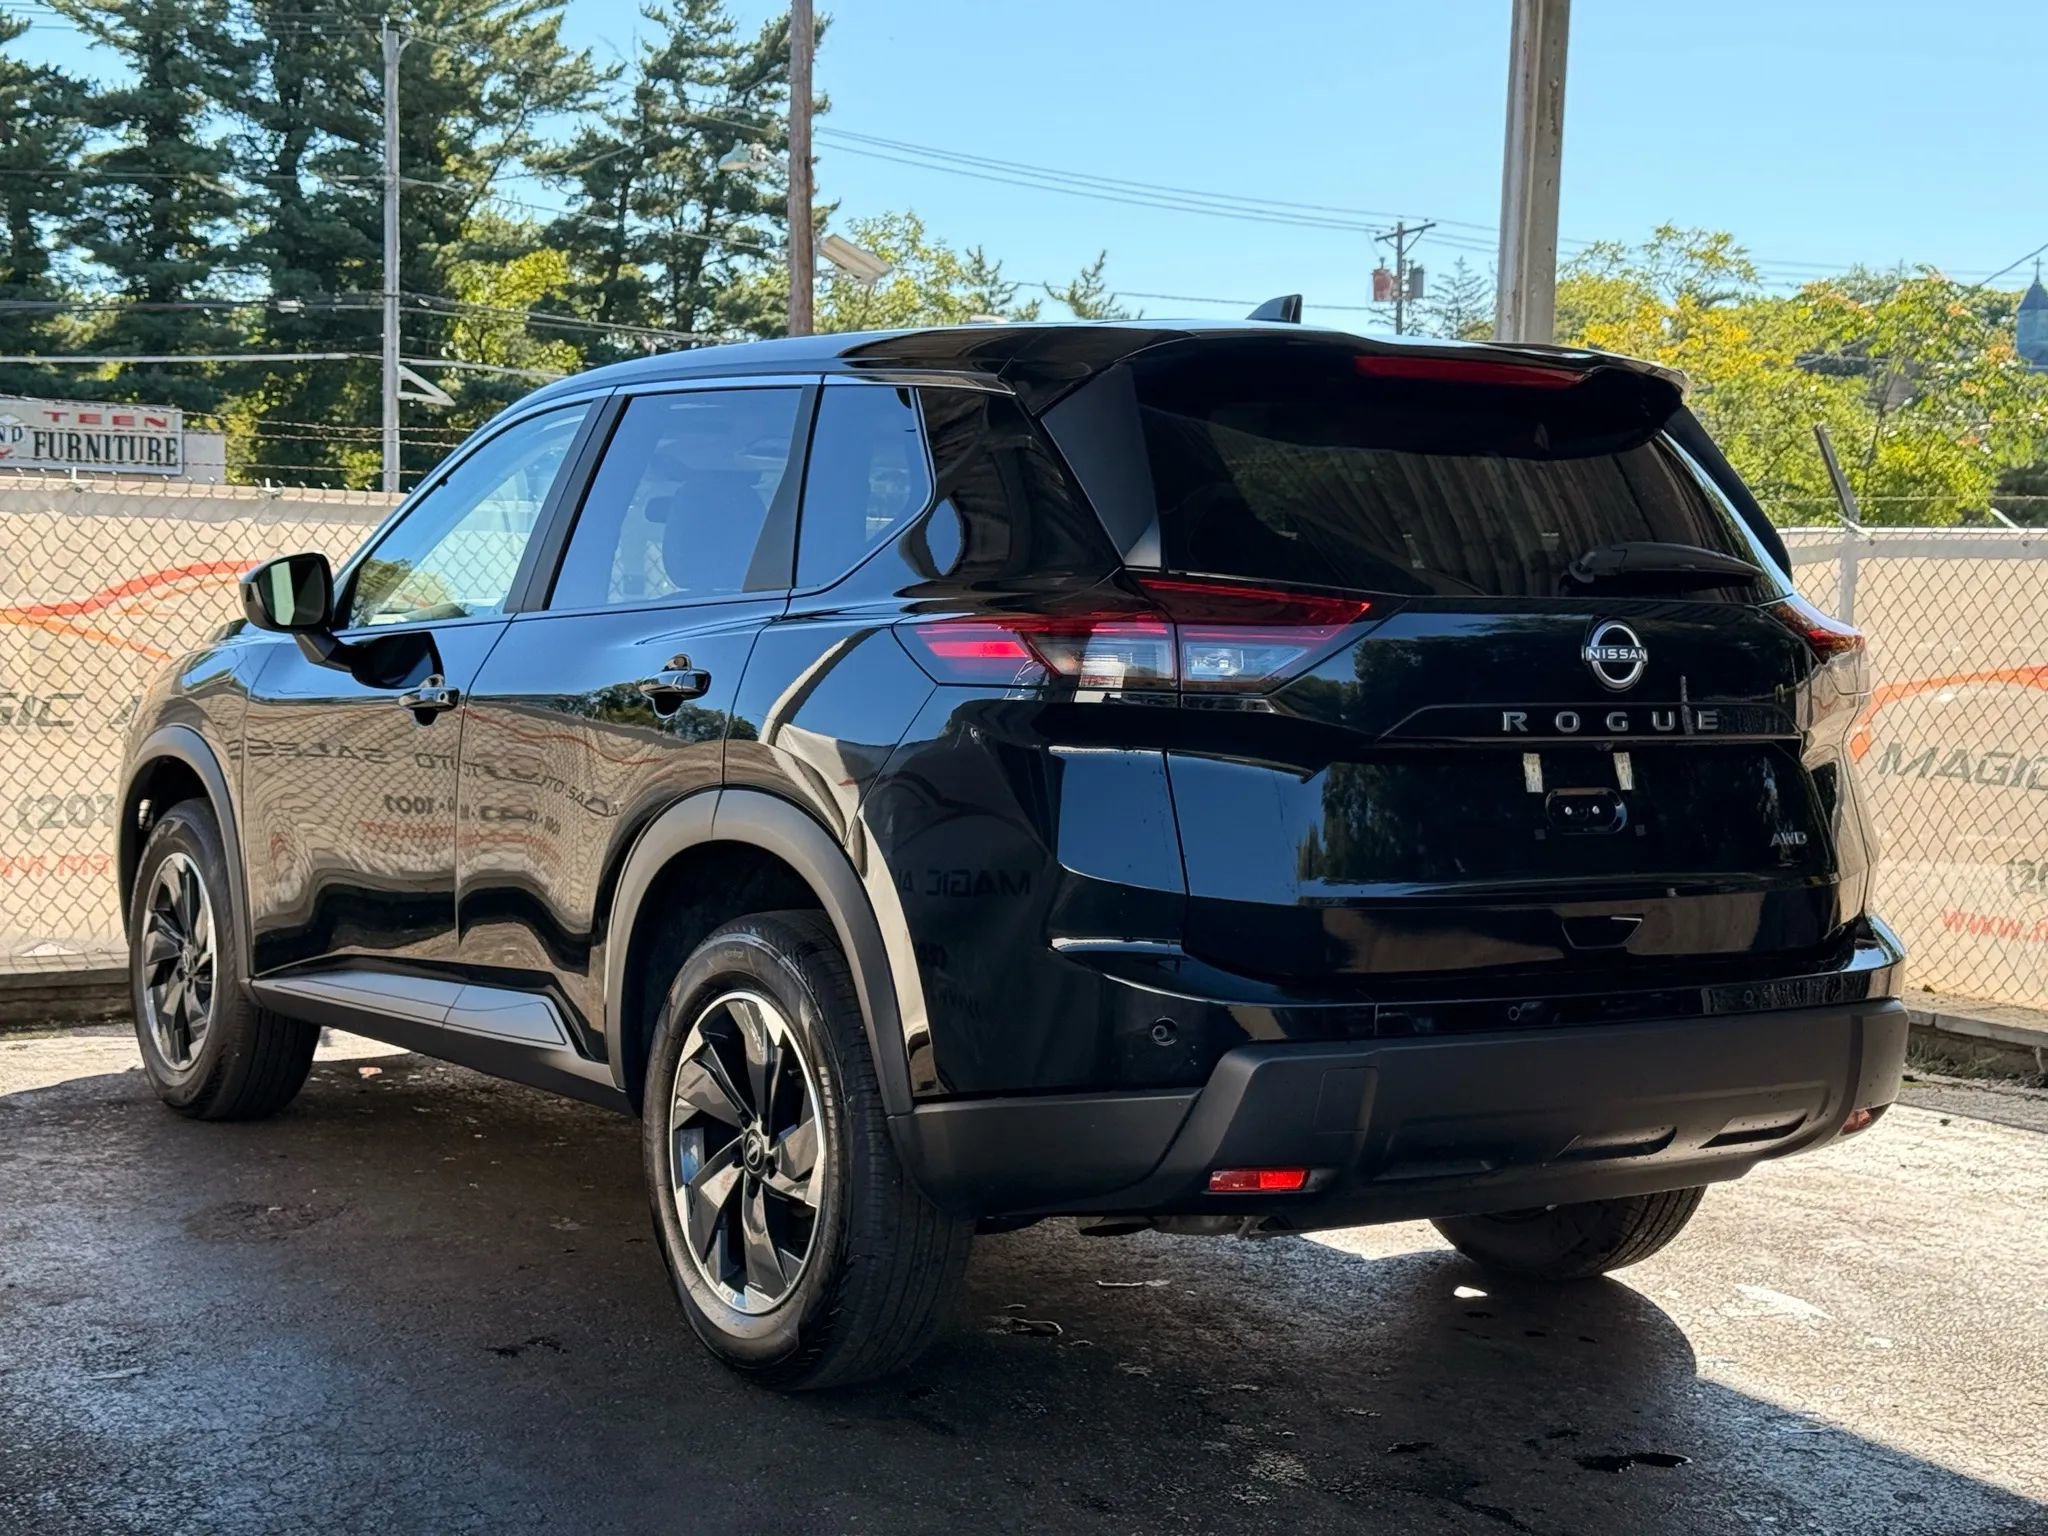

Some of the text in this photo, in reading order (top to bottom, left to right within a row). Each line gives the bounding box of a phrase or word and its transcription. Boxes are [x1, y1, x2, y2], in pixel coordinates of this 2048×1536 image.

[43, 411, 168, 427] TEEN
[33, 431, 178, 467] FURNITURE
[1586, 648, 1648, 661] NISSAN
[1502, 711, 1719, 733] ROGUE
[1770, 831, 1808, 847] AWD
